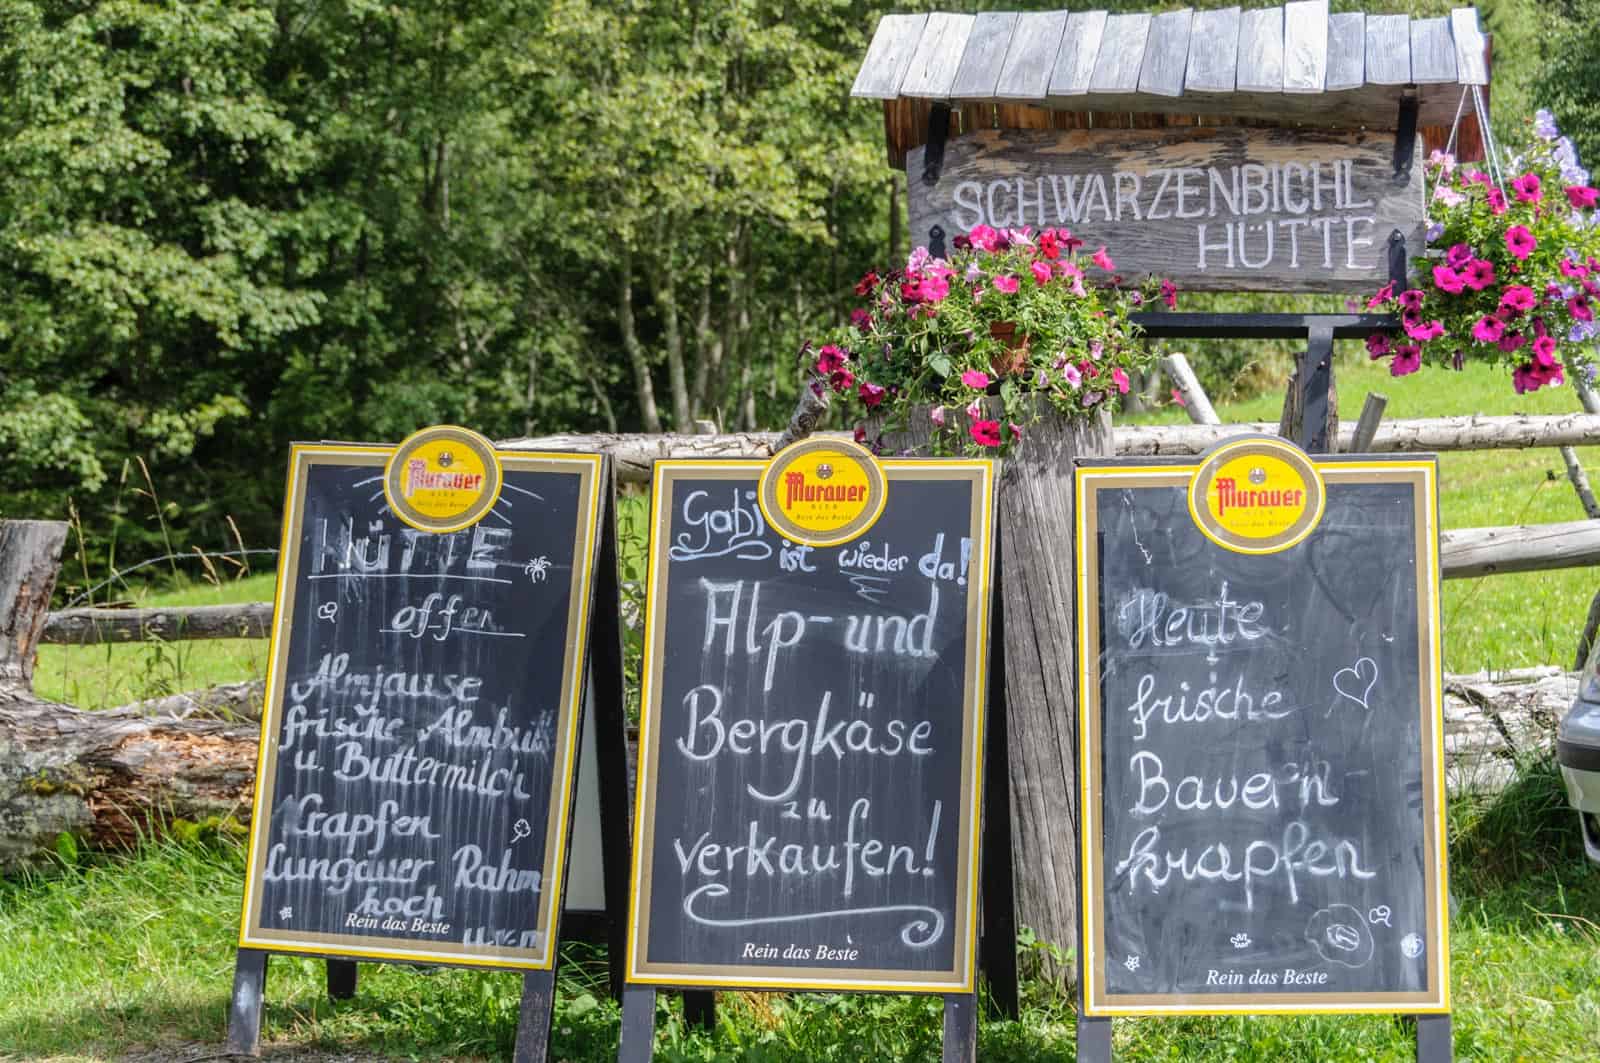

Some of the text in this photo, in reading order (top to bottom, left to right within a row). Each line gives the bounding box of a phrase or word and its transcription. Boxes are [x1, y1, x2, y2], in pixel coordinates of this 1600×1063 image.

[951, 160, 1374, 231] SCHWARZENBICHL
[1196, 215, 1377, 270] HÜTTE
[405, 459, 482, 496] Murauer
[785, 471, 866, 509] Murauer
[1215, 477, 1302, 517] Murauer
[683, 488, 766, 546] Gabi
[780, 533, 974, 585] ist wieder da!
[391, 592, 497, 641] offen
[844, 583, 941, 658] und
[1117, 580, 1266, 650] Heute
[291, 652, 482, 716] Almjause
[1128, 673, 1292, 741] frische
[278, 704, 405, 751] frische
[676, 684, 936, 801] Bergkäse
[334, 741, 531, 800] Buttermilch
[1129, 750, 1340, 815] Bauern
[780, 797, 832, 820] zu
[263, 844, 543, 896] Lungauer Rahm
[345, 912, 450, 935] Rein das Beste
[742, 943, 859, 962] Rein das Beste
[1206, 968, 1329, 986] Rein das Beste
